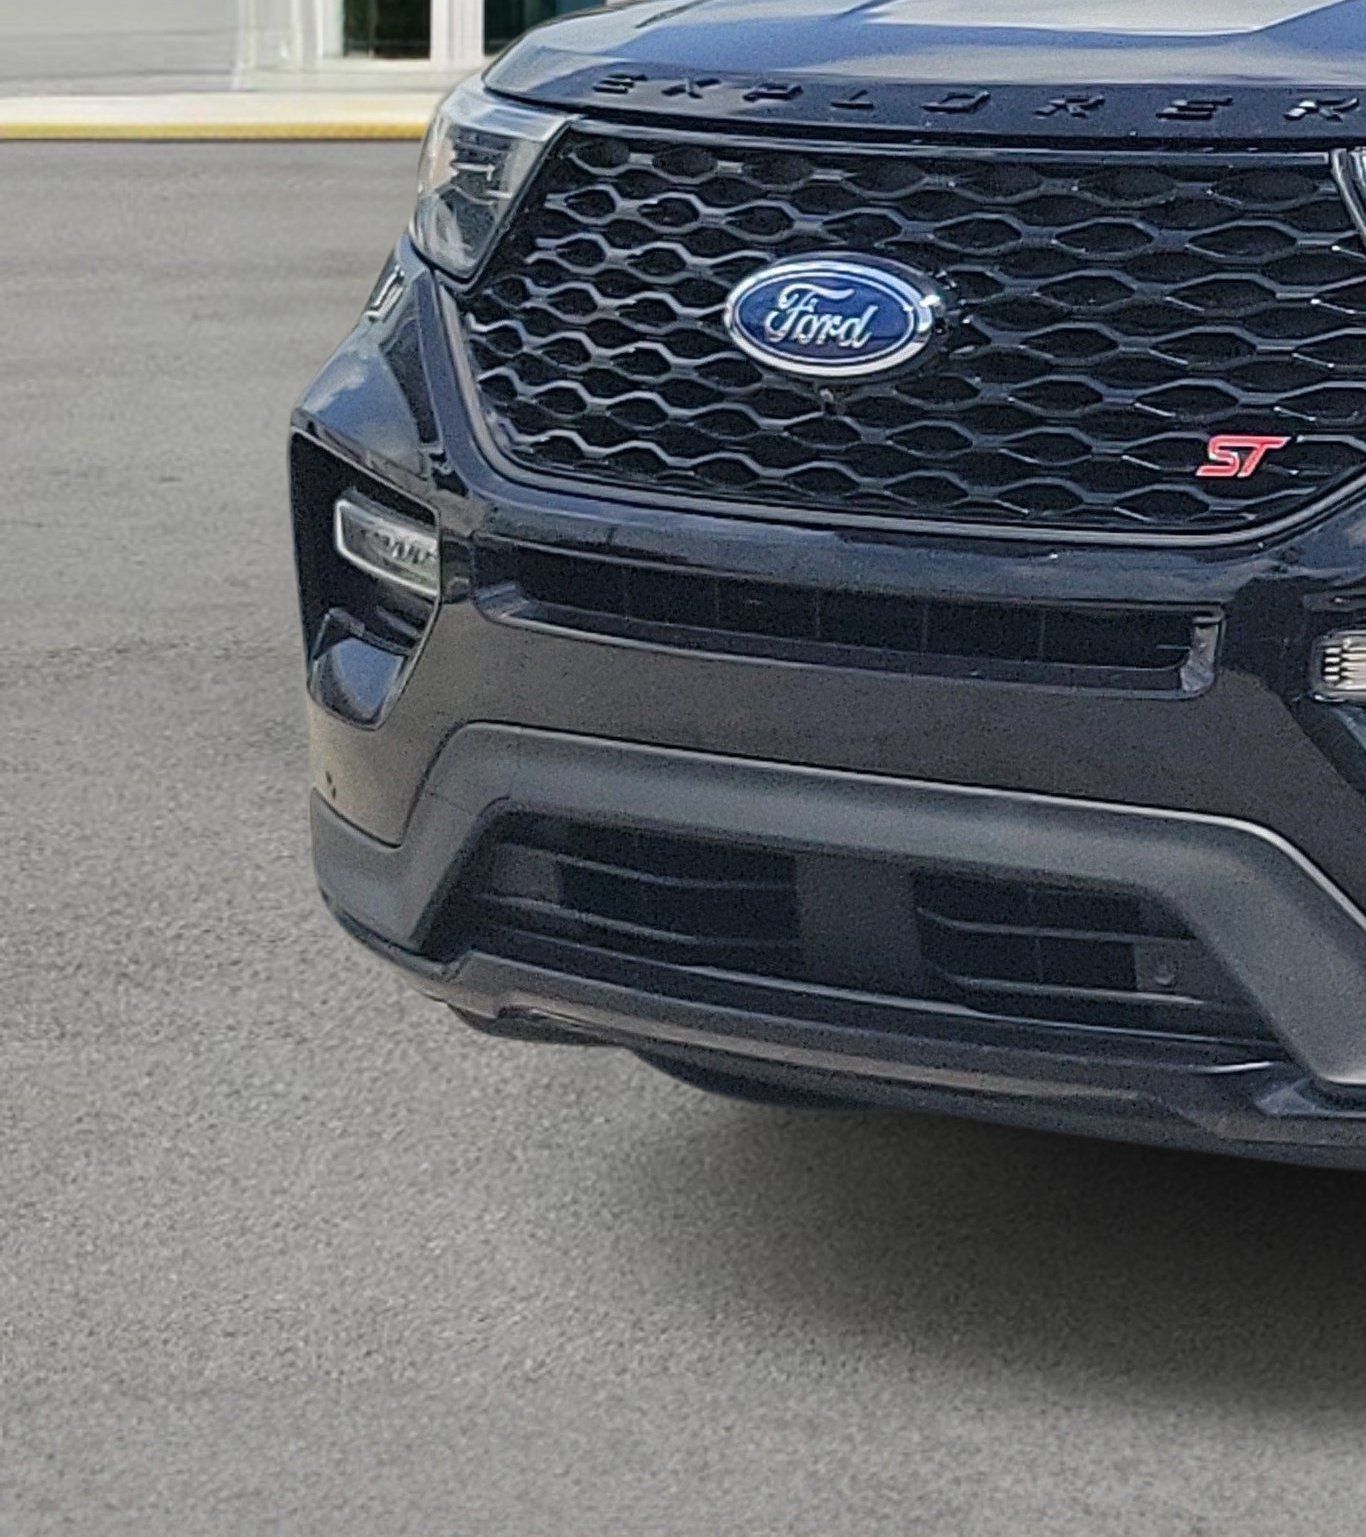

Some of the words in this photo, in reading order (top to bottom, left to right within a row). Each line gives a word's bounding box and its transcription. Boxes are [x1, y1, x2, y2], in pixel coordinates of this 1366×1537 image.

[592, 73, 1360, 123] EXPLORER
[764, 282, 878, 349] Ford
[1195, 435, 1292, 478] ST
